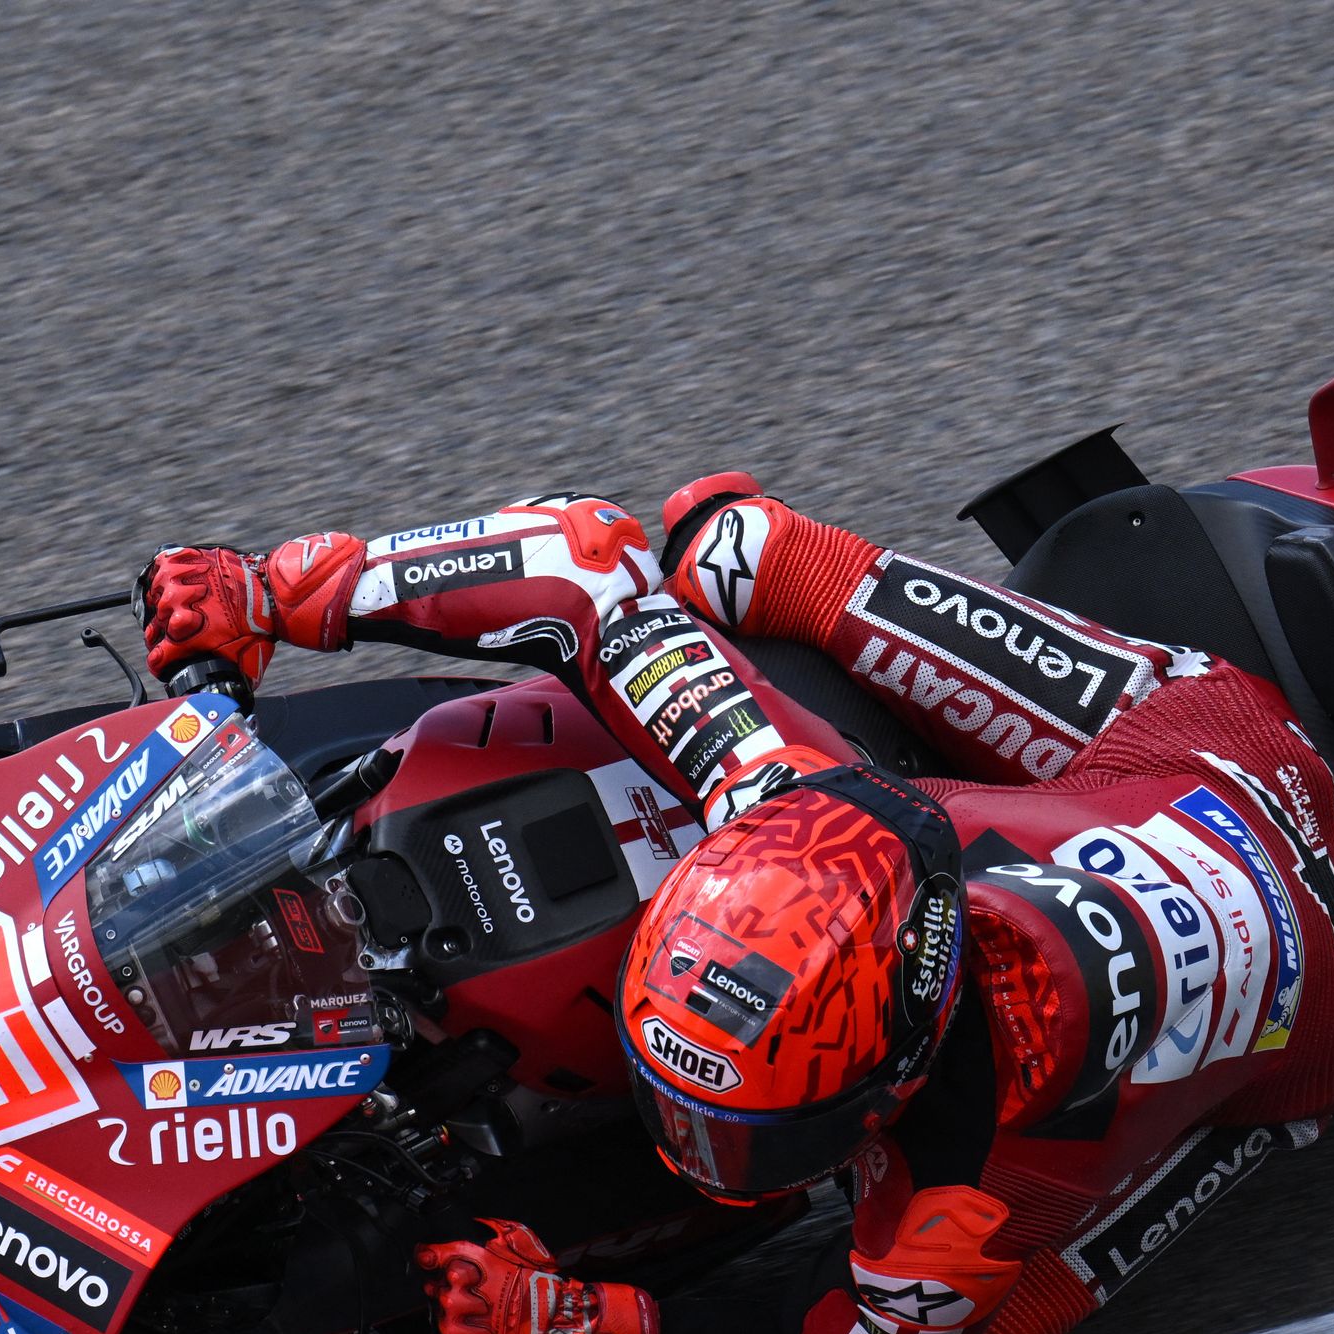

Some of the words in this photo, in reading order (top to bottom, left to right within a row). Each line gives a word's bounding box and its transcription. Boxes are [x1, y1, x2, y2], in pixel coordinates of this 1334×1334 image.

[390, 518, 486, 552] Unipol
[403, 550, 513, 585] Lenovo
[903, 578, 1107, 708] Lenovo
[655, 670, 737, 747] aruba.it
[852, 635, 1077, 781] DUCATI
[43, 746, 150, 881] ADVANCE
[457, 857, 495, 933] motorola
[479, 819, 535, 924] Lenovo
[1176, 844, 1234, 900] Spo
[1202, 810, 1300, 971] MICHELIN
[55, 910, 125, 1036] VARGROUP
[676, 939, 702, 958] DUCATI
[910, 897, 945, 1001] Estrella
[930, 908, 958, 1002] Galicia
[986, 863, 1141, 1073] enovo
[1228, 910, 1255, 998] Audi
[310, 993, 368, 1008] MARQUEZ
[339, 1018, 368, 1028] Lenovo
[706, 966, 767, 1012] Lenovo
[717, 1000, 741, 1018] FACTORY
[188, 1021, 297, 1051] WRS
[650, 1025, 726, 1089] SHOEI
[205, 1061, 360, 1098] ADVANCE
[639, 1066, 674, 1098] Estrella
[674, 1094, 716, 1119] Galicia
[149, 1107, 297, 1165] riello
[23, 1170, 152, 1253] FRECCIAROSSA
[1110, 1128, 1272, 1277] Lenovo
